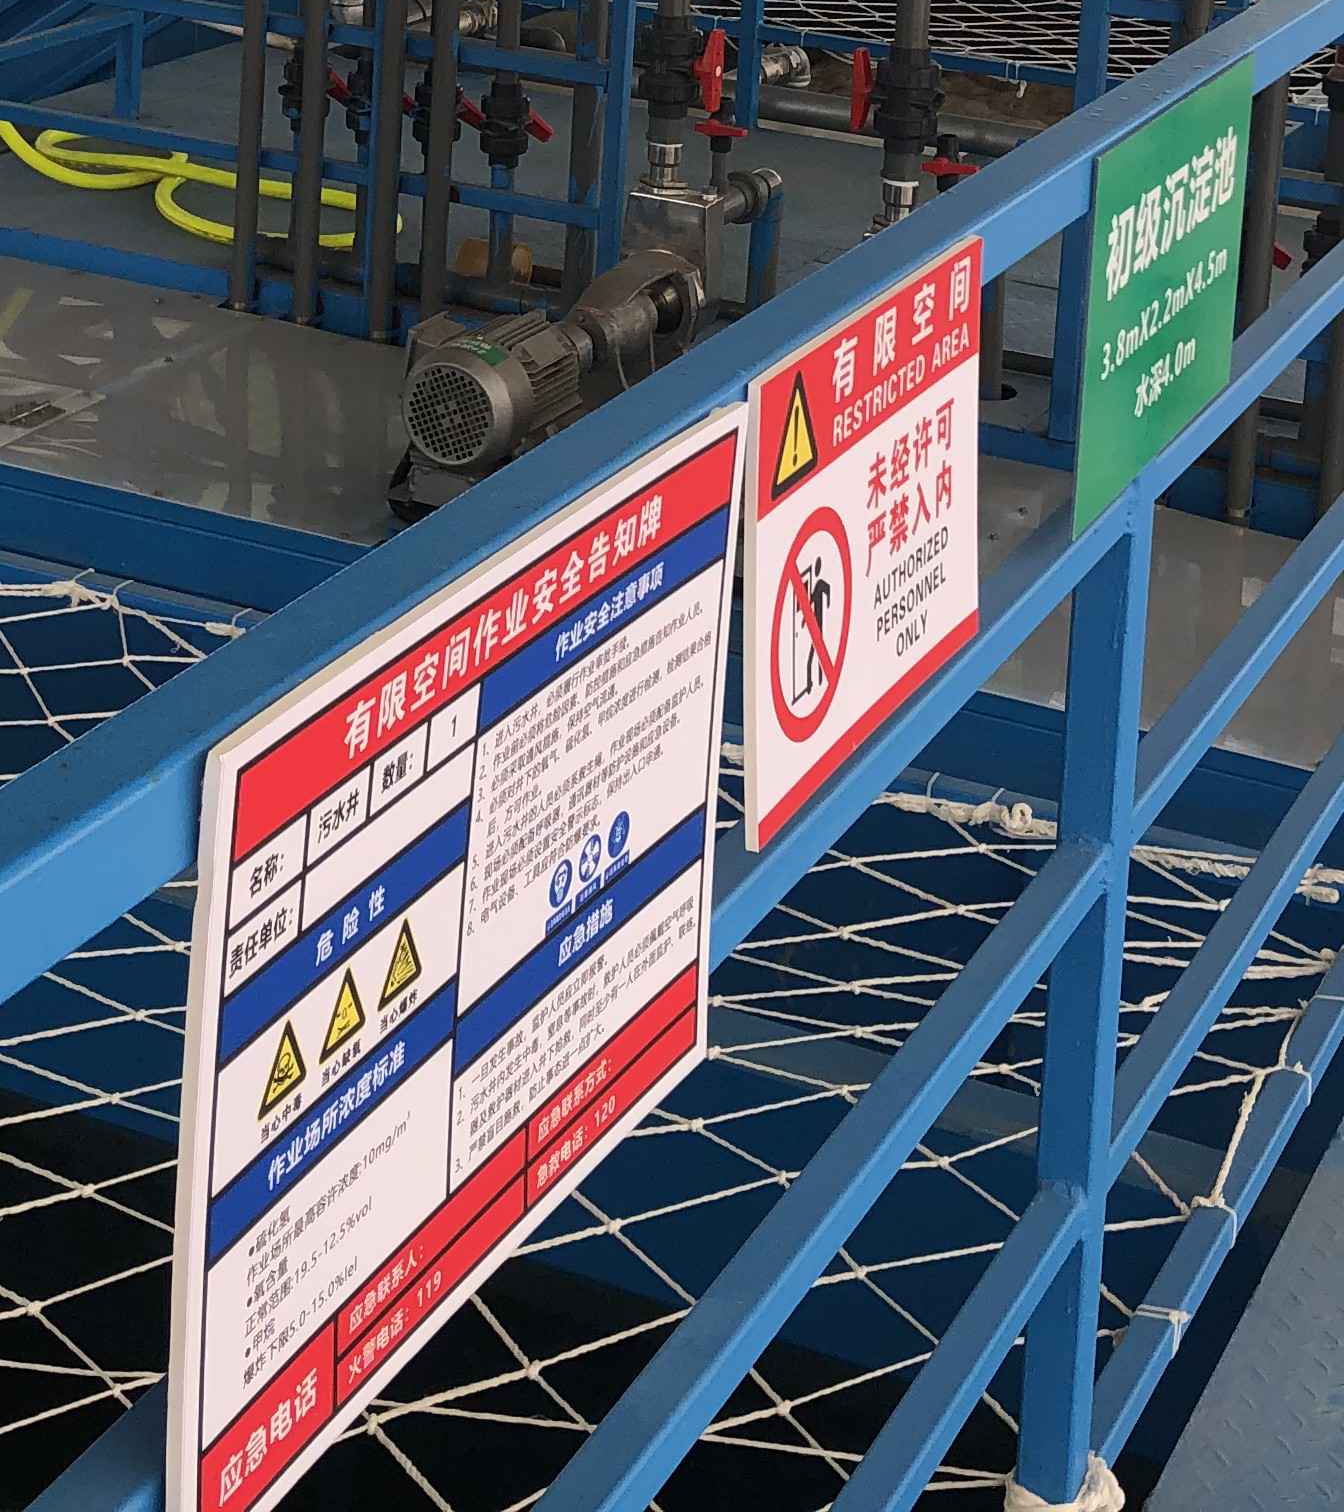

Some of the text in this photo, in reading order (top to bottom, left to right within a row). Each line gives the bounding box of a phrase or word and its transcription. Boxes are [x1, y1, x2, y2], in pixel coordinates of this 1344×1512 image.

[1104, 125, 1238, 302] 初级沉淀池
[831, 254, 971, 402] 有限空间
[1099, 246, 1229, 381] 3.8mX2.2mX4.5m
[832, 327, 970, 447] RESTRICTED AREA
[1133, 339, 1197, 419] 水深4.0m
[866, 396, 956, 518] 未经许可
[865, 460, 954, 578] 严禁入内
[872, 525, 950, 610] AUTHORIZED
[344, 494, 664, 760] 有限空间作业安全告知牌
[555, 561, 664, 662] 作业安全注意事项
[874, 564, 947, 643] PERSONNEL
[895, 616, 928, 658] ONLY
[318, 789, 360, 844] 污水井
[315, 884, 386, 968] 危险性
[558, 898, 614, 968] 应急措施
[260, 1092, 303, 1144] 当心中毒
[268, 1040, 406, 1192] 作业场所浓度标准
[219, 1367, 318, 1507] 应急电话
